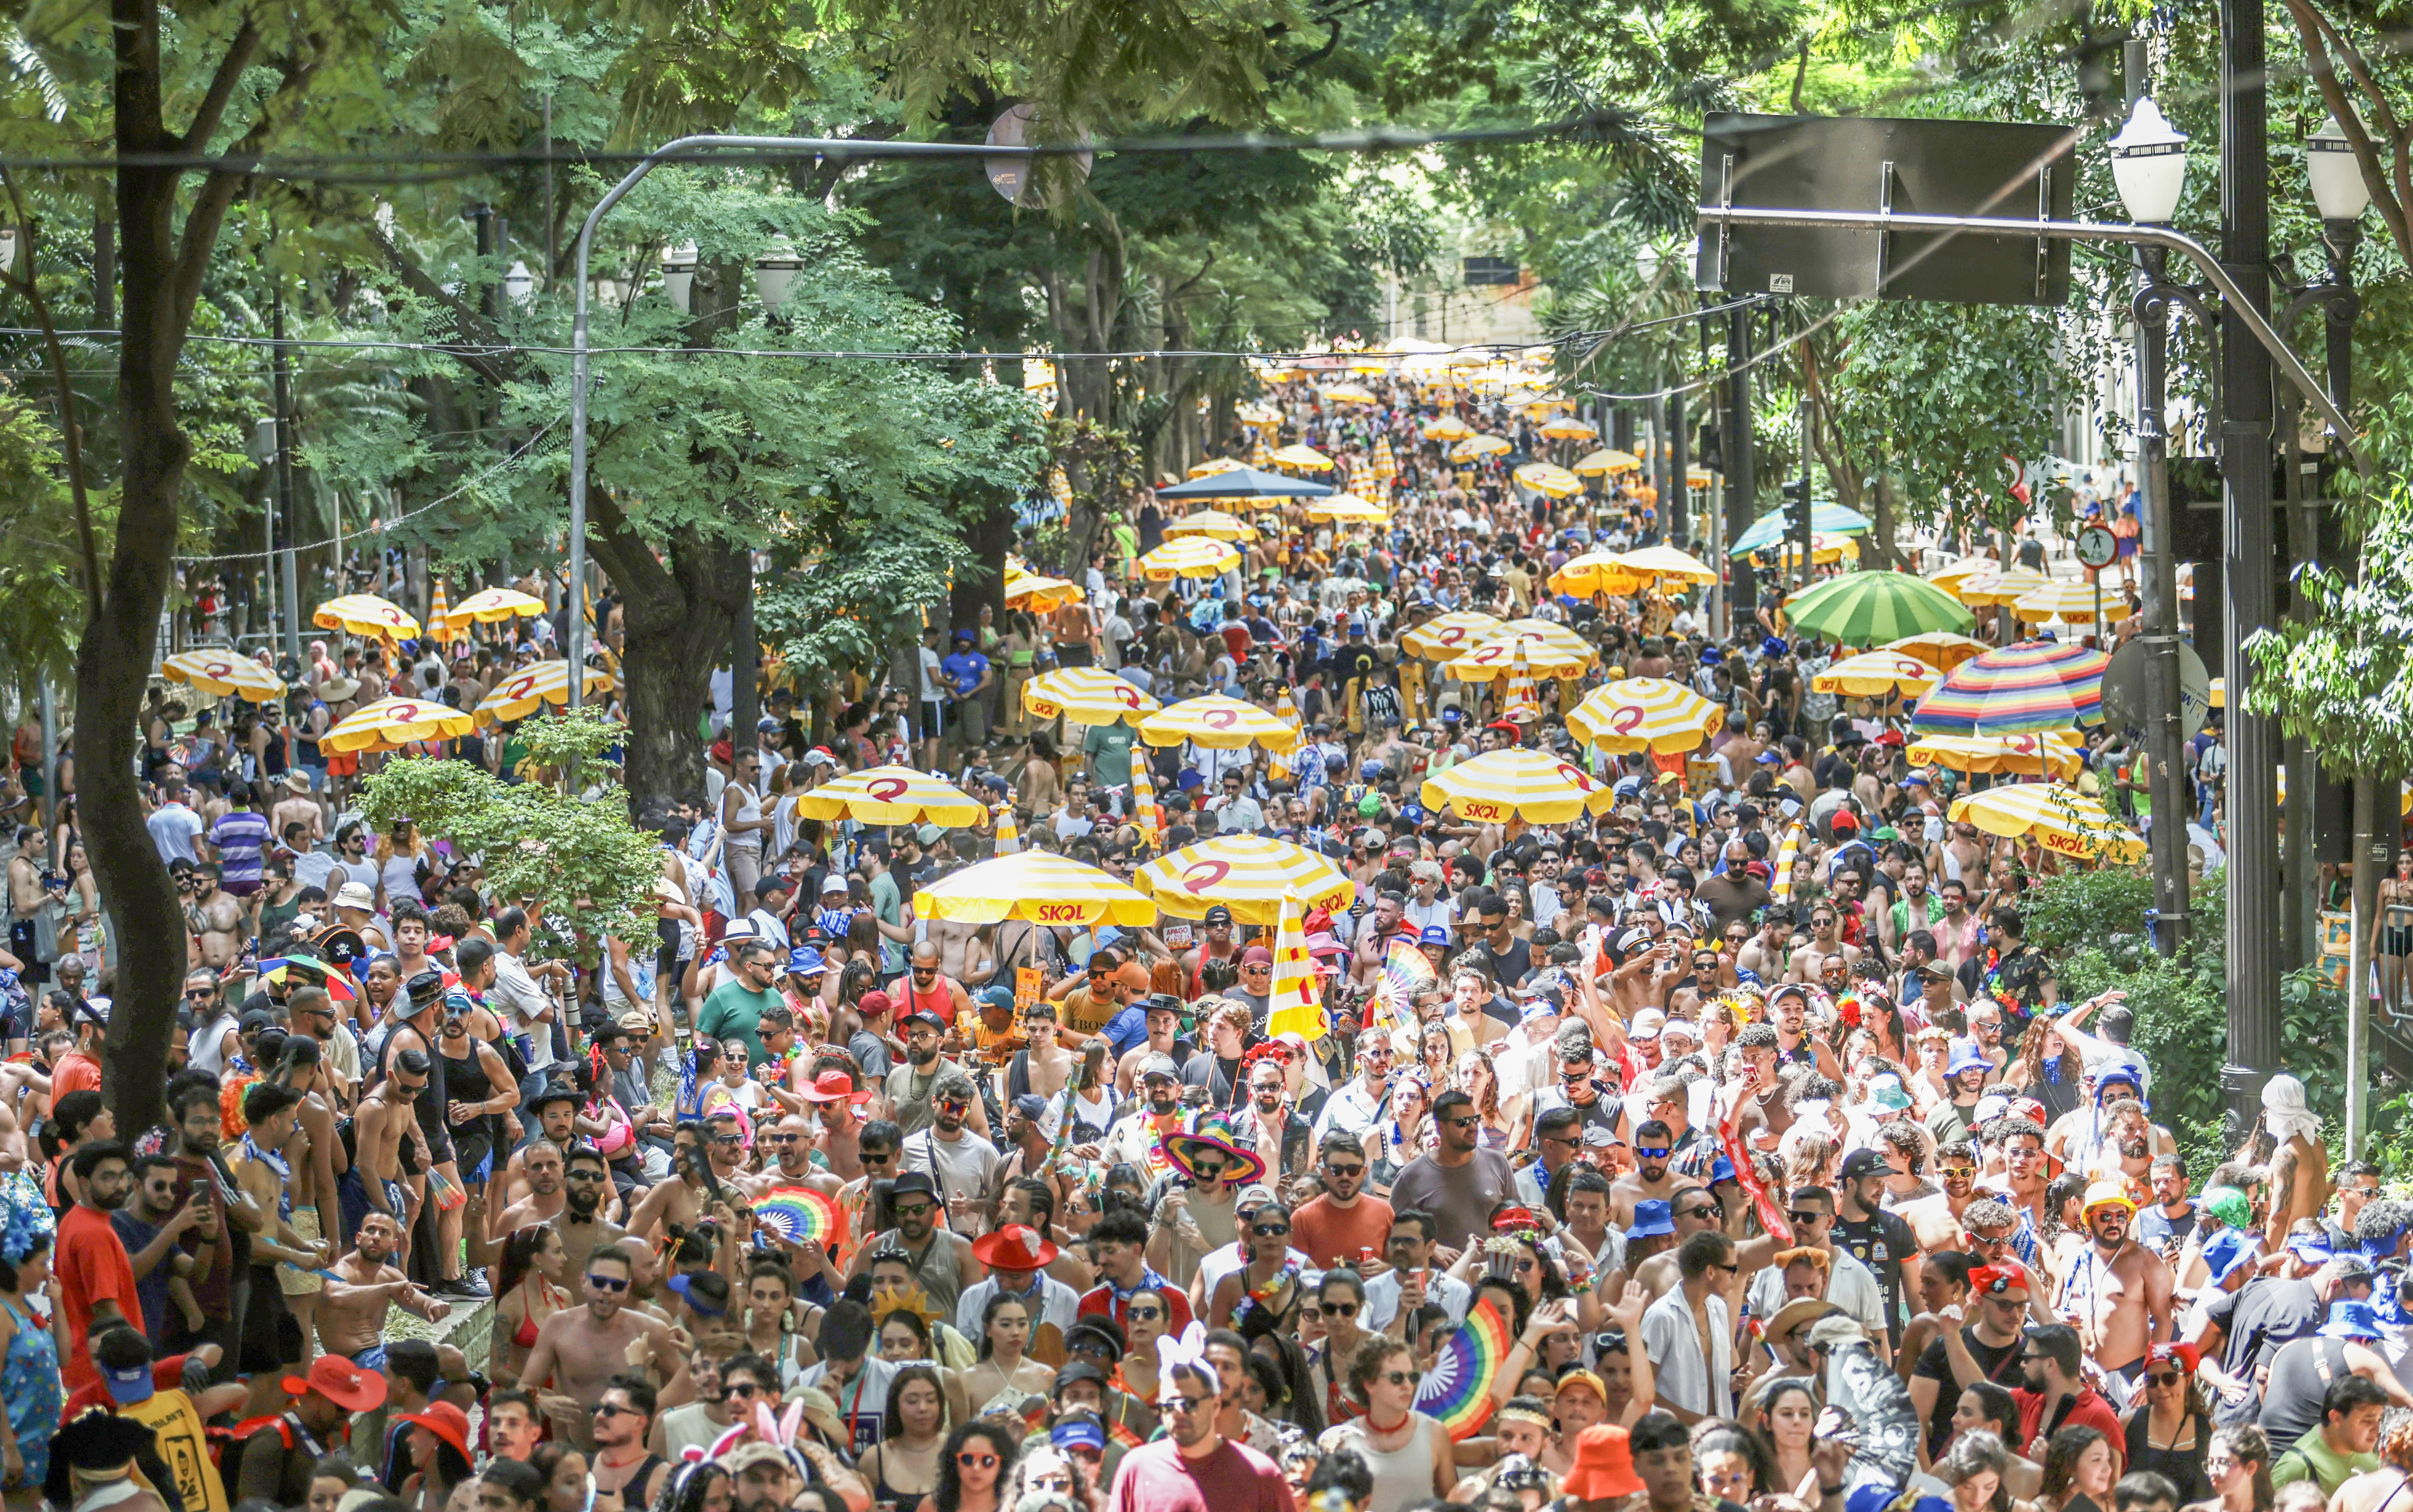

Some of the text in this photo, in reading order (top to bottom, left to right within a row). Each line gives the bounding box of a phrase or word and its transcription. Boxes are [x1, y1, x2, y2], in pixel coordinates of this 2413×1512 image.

[1911, 751, 1930, 764] SKOL
[1464, 804, 1500, 820] SKOL
[2047, 834, 2084, 854] SKOL
[1320, 892, 1346, 914] SKOL
[1039, 905, 1086, 922] SKOL
[2022, 1234, 2030, 1252] Sorte
